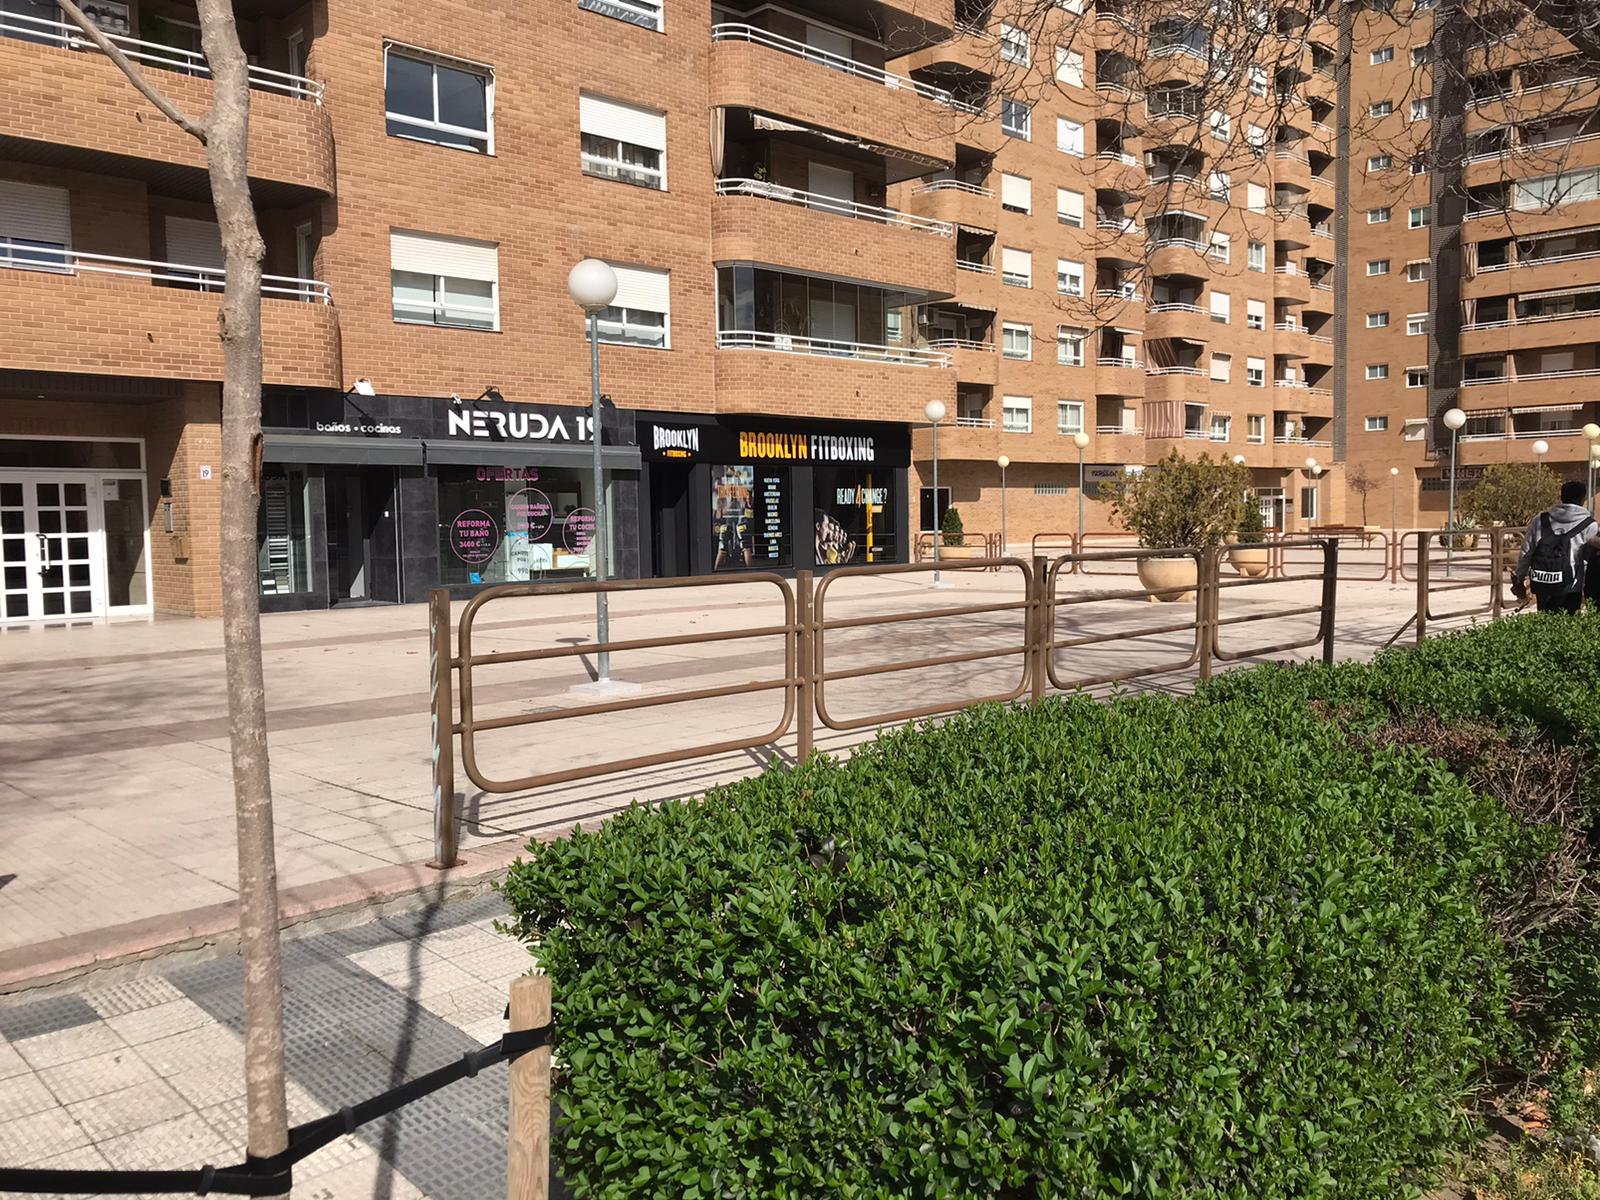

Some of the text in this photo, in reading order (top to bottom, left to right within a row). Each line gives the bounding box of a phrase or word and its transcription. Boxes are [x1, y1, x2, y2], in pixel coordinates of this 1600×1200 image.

[316, 421, 402, 434] baños cocinas
[448, 409, 571, 441] NERUDA
[653, 424, 699, 452] BROOKLYN
[739, 431, 875, 461] BROOKLYN FITBOXING
[202, 469, 210, 477] 19
[475, 467, 539, 481] OFERTAS
[836, 487, 856, 505] READY
[855, 484, 862, 509] 4
[457, 520, 491, 528] REFORMA
[470, 528, 490, 537] BAÑO
[1531, 570, 1560, 582] PUMA
